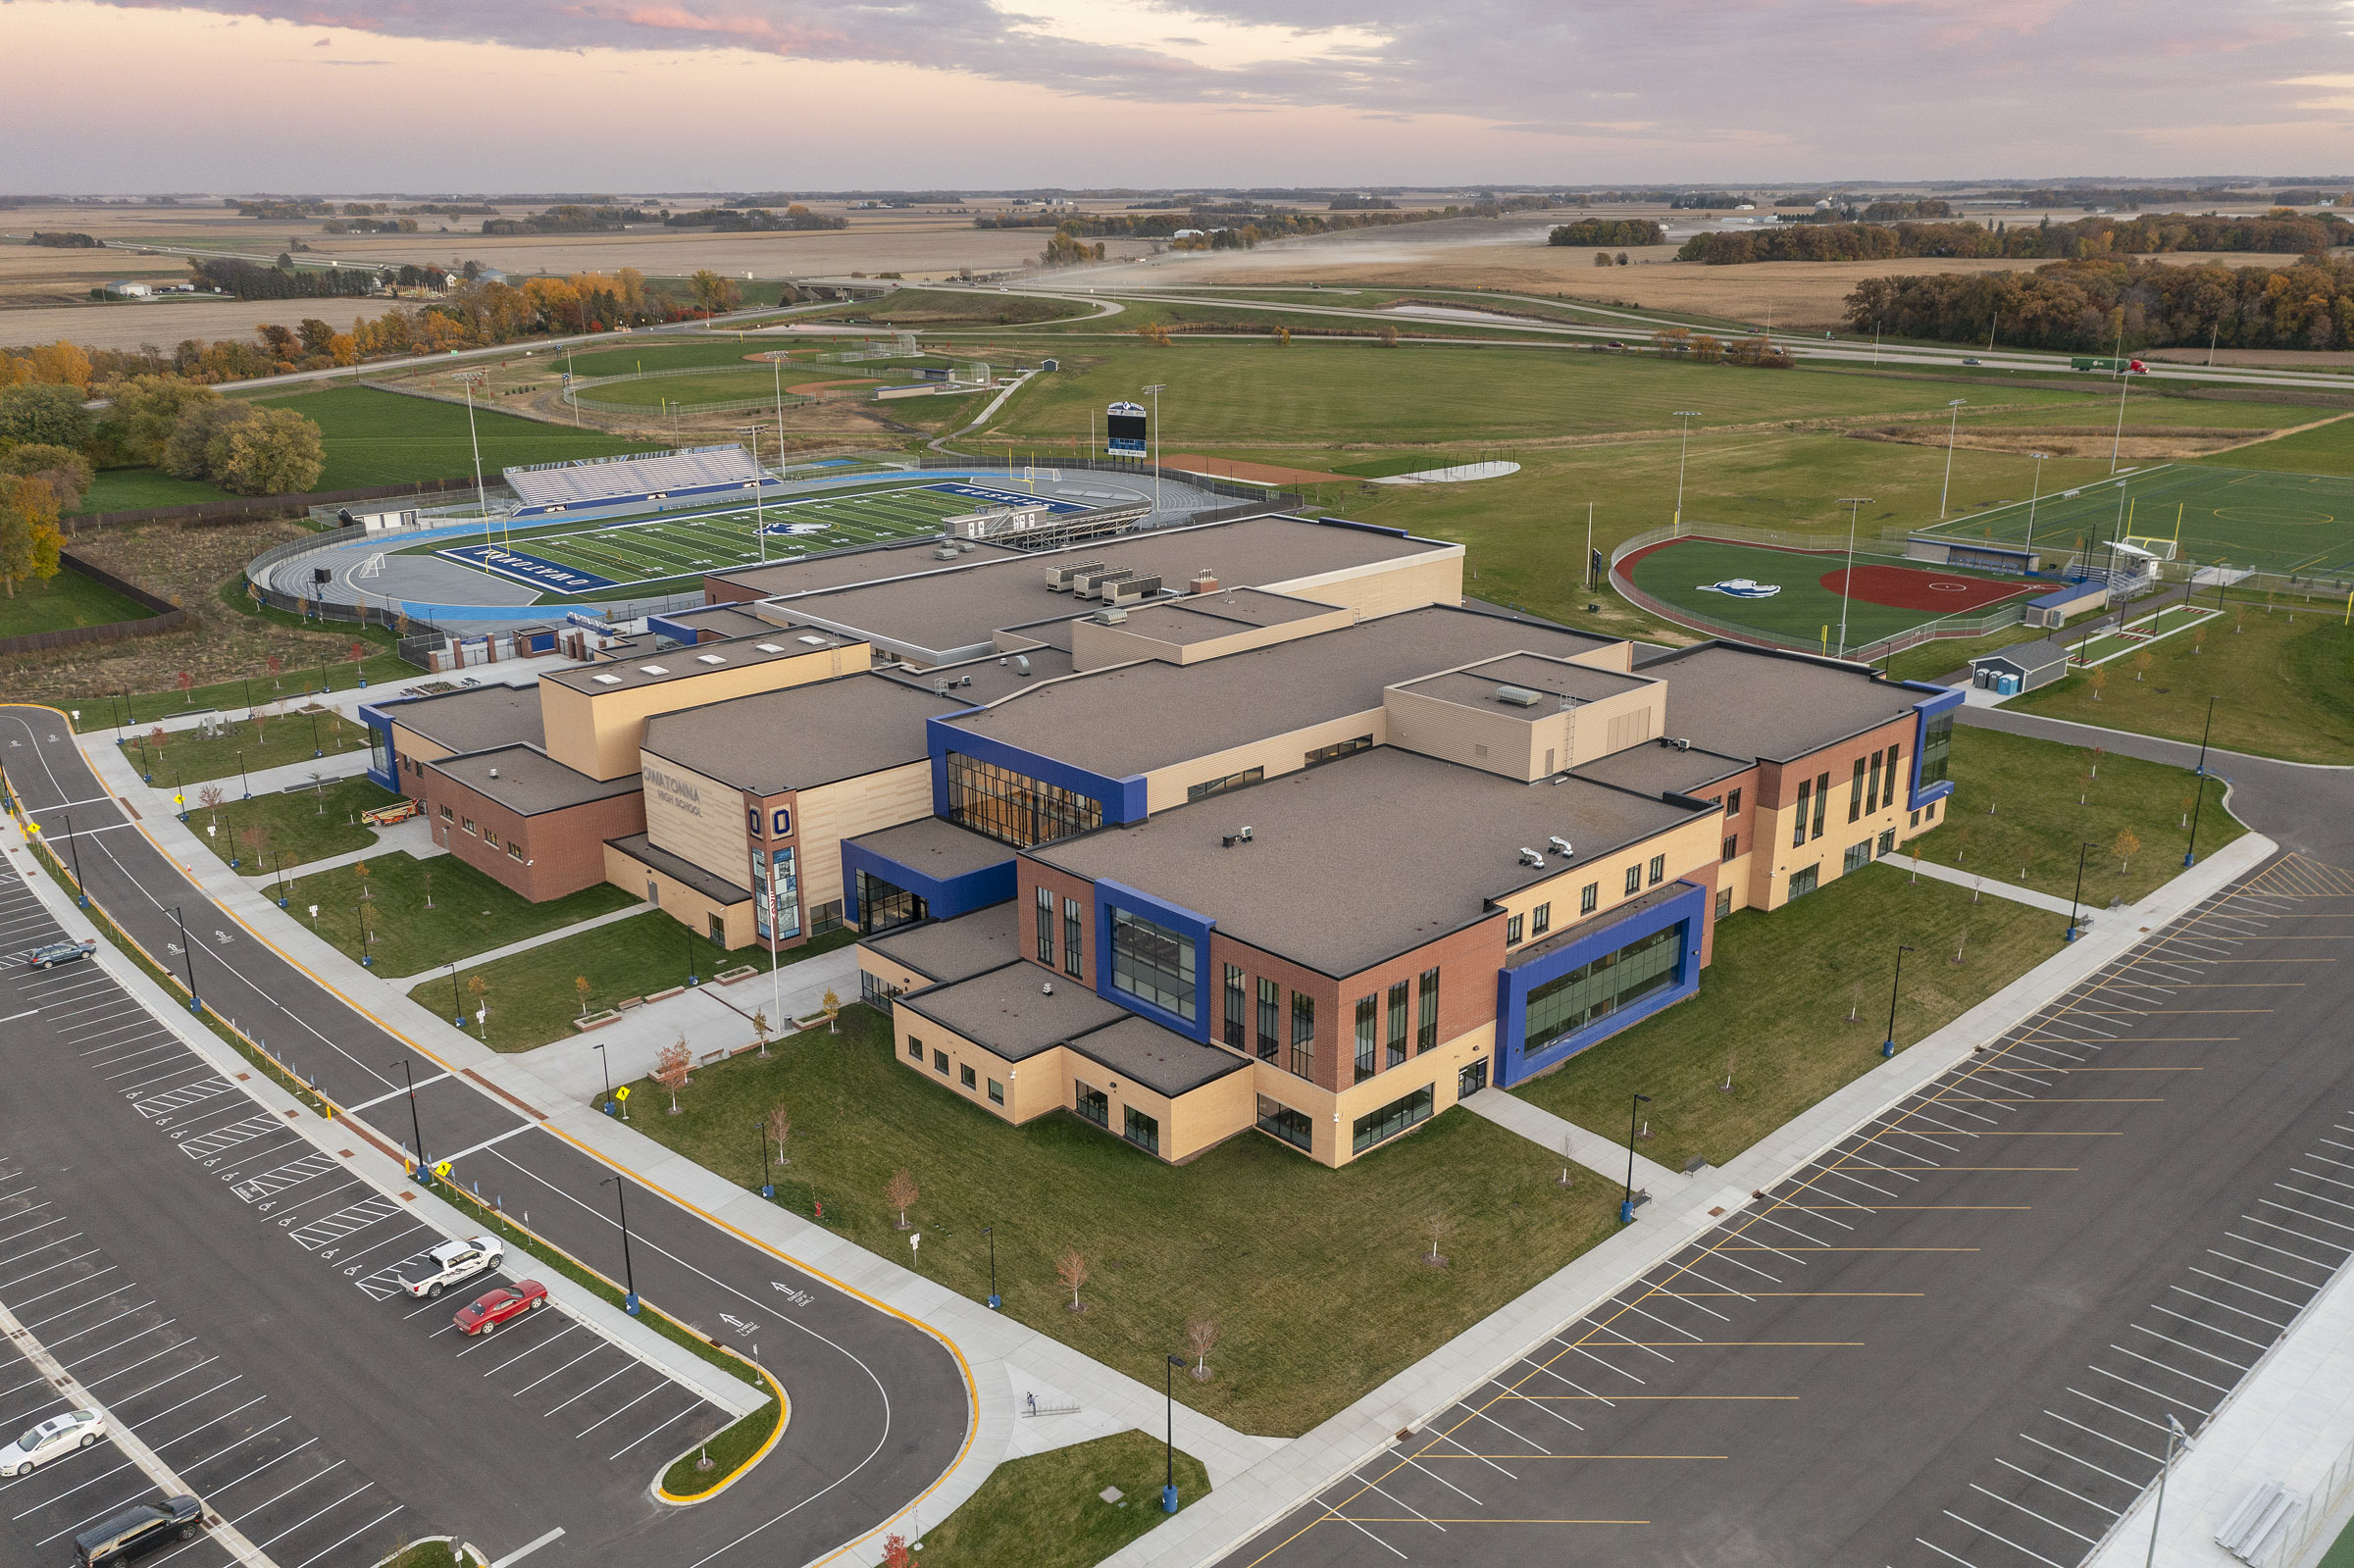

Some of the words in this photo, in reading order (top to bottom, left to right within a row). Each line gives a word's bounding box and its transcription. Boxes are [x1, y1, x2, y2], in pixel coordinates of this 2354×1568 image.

[642, 766, 701, 804] OWATONNA
[657, 789, 675, 805] HIGH
[674, 797, 703, 818] SCHOOL
[787, 1290, 805, 1302] DROP
[794, 1293, 808, 1303] OFF
[797, 1295, 816, 1307] ONLY
[735, 1321, 755, 1334] THRU
[741, 1325, 761, 1337] LANE
